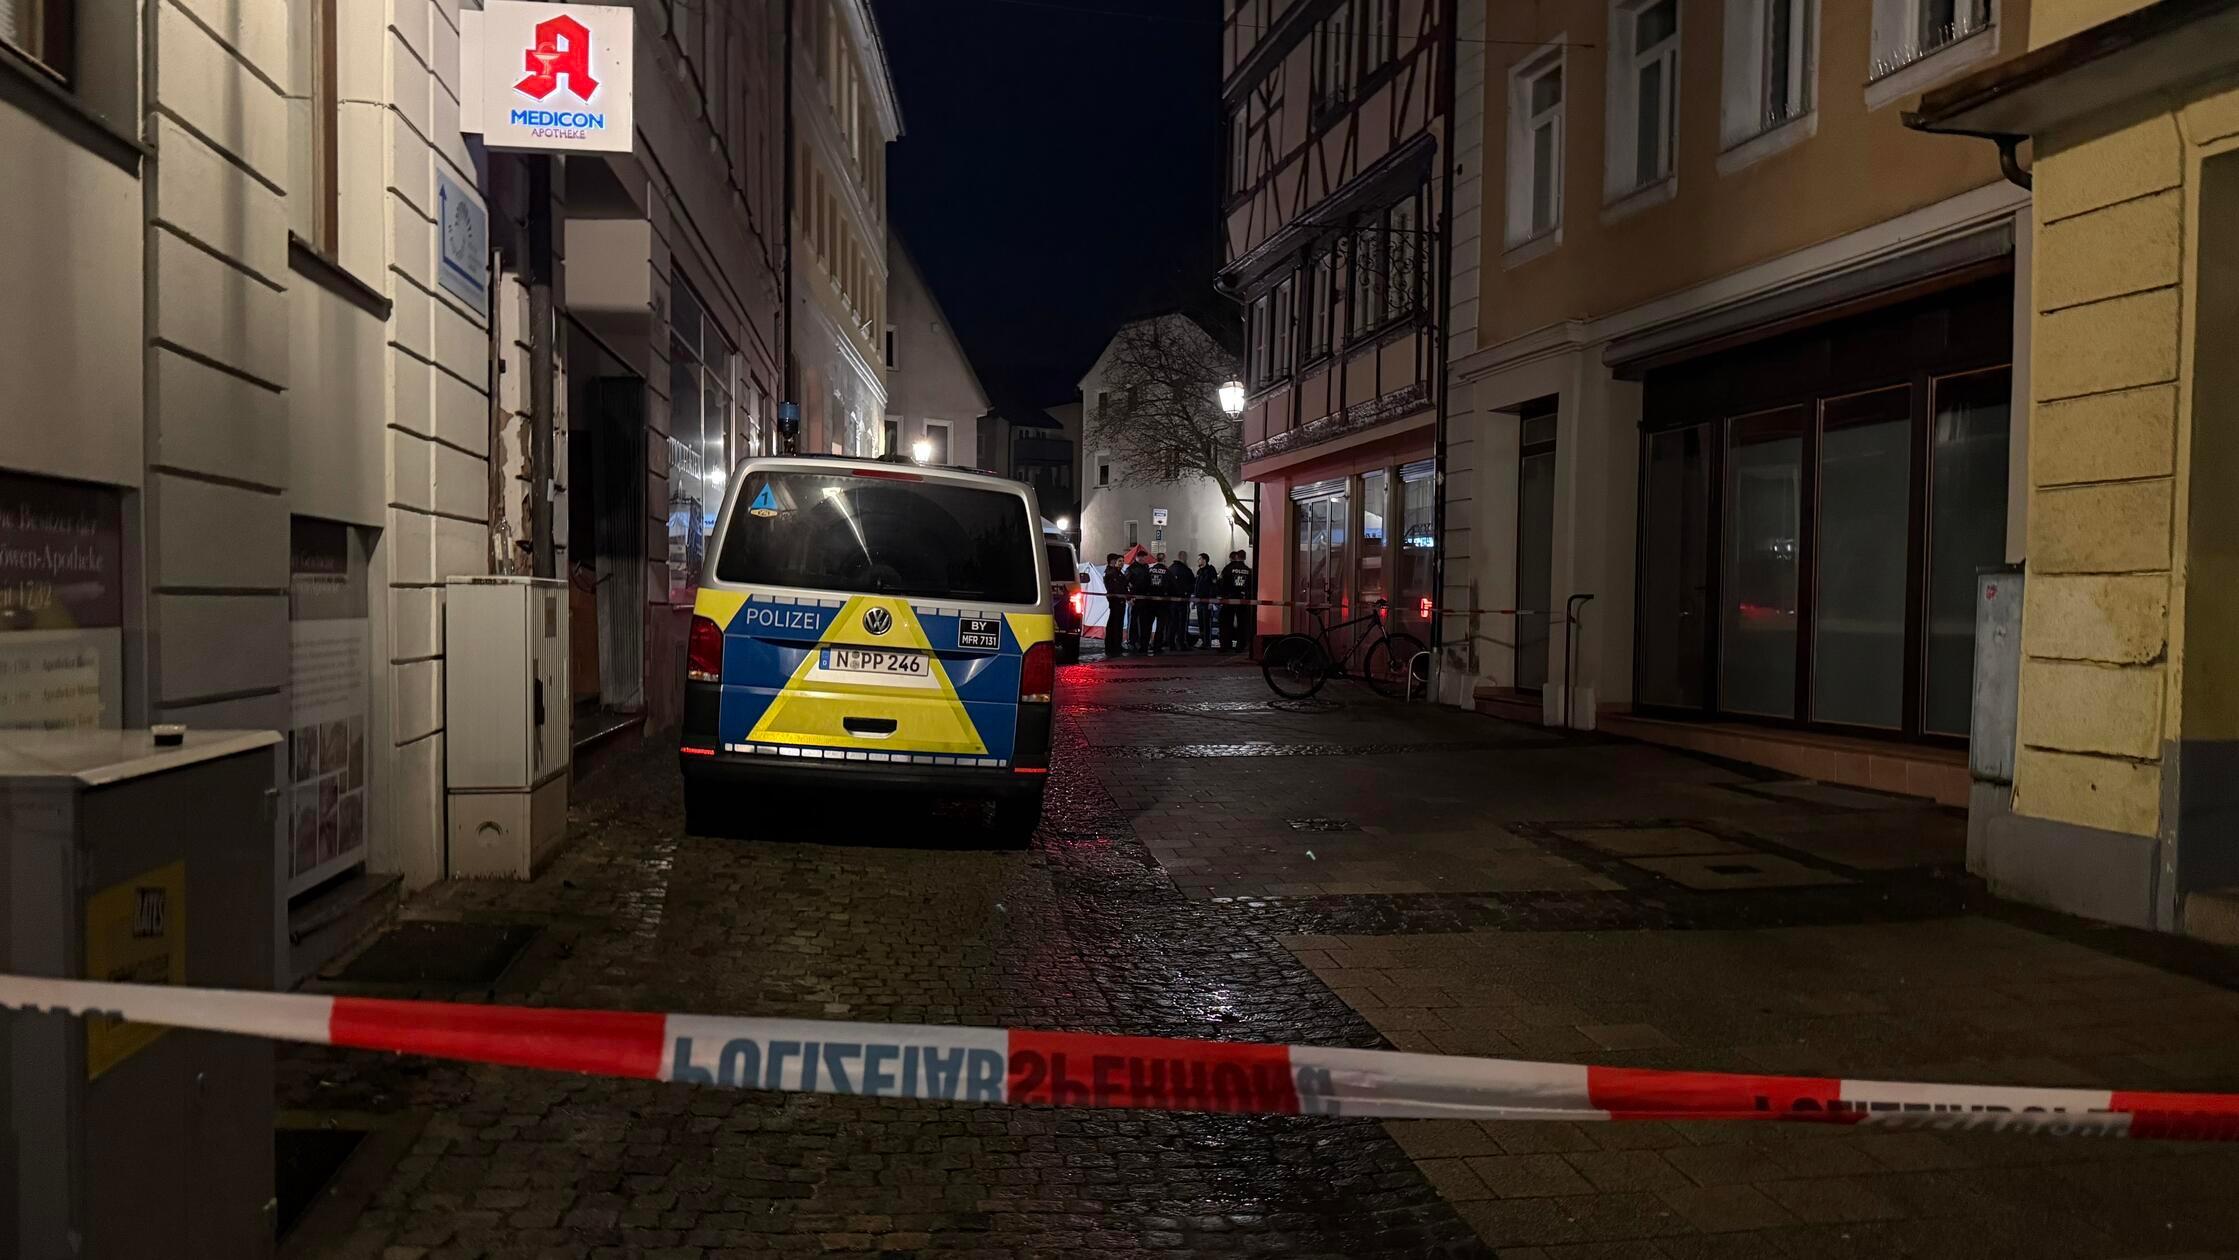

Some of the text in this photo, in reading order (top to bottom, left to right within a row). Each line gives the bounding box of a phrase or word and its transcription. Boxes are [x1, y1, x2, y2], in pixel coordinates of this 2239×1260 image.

[511, 109, 604, 129] MEDICON
[531, 128, 586, 140] APOTHEKE
[0, 542, 104, 577] öwen-Apotheke
[746, 608, 820, 630] POLIZEI
[971, 621, 987, 631] BY
[962, 635, 997, 646] MFR 7131
[836, 650, 920, 673] N PP 246
